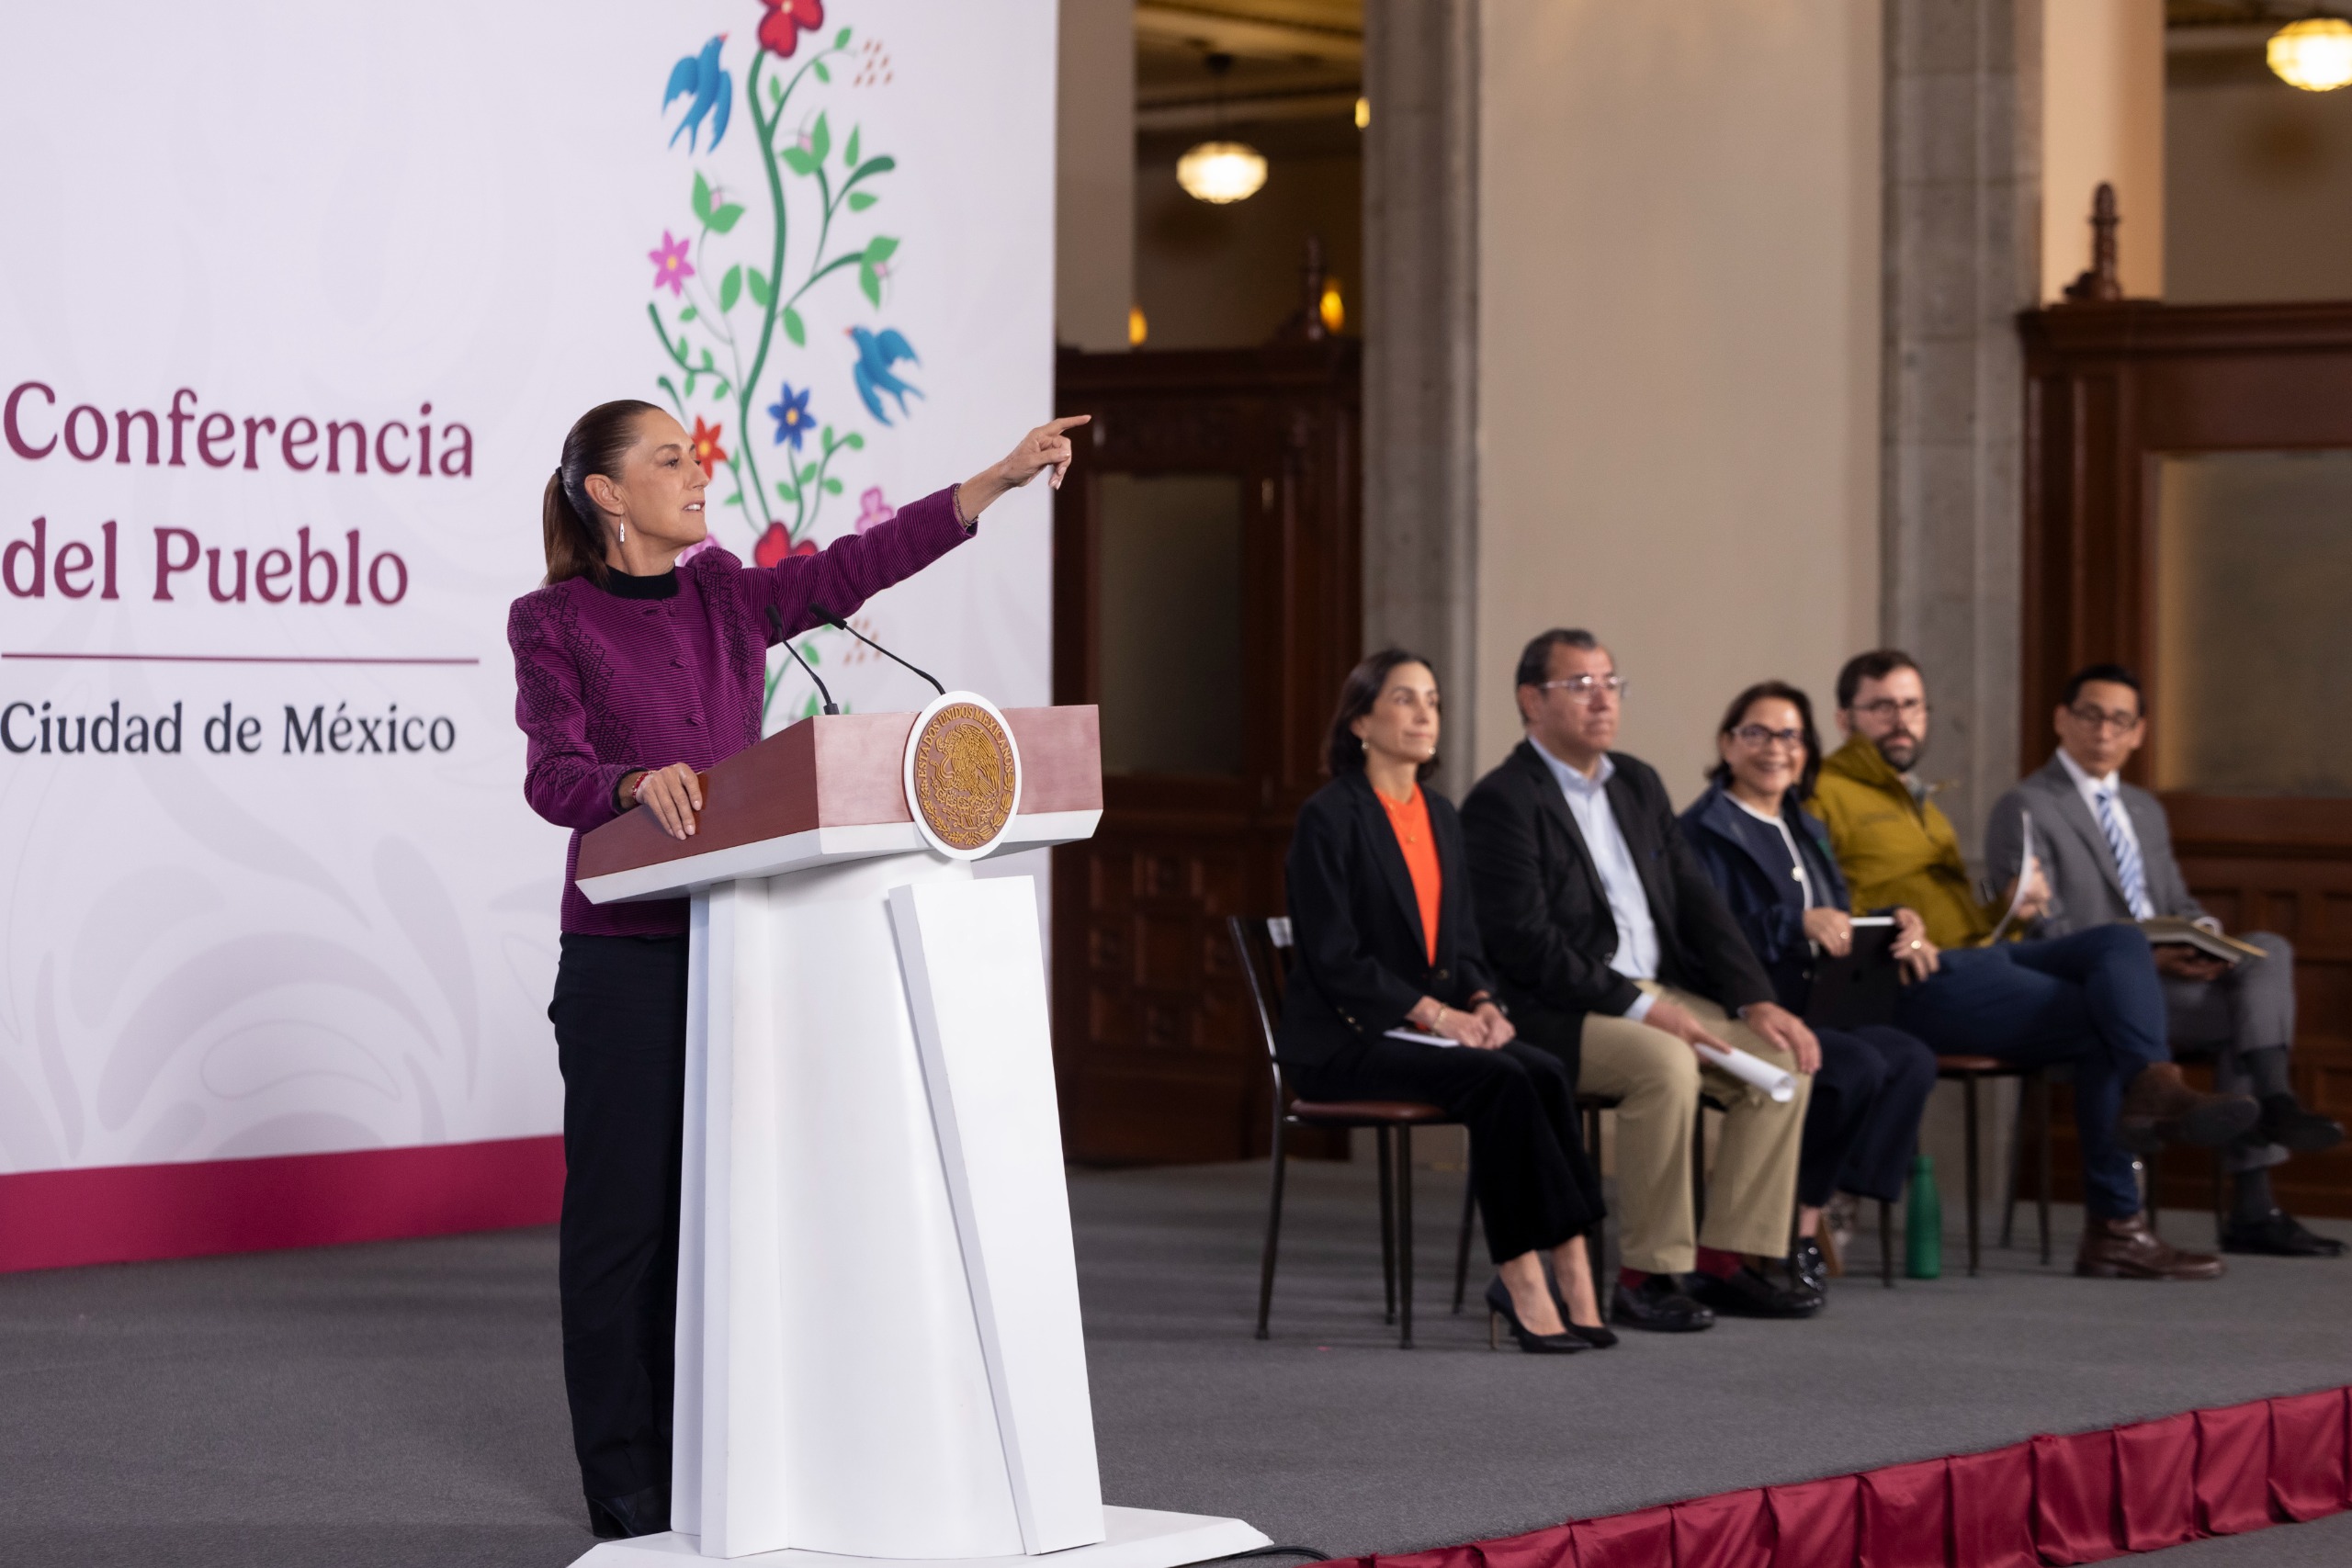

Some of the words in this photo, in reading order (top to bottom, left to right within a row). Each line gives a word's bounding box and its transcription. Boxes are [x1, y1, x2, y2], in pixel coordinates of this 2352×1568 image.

[3, 380, 473, 478] Conferencia
[2, 515, 120, 601] del
[152, 525, 409, 606] Pueblo
[0, 699, 184, 755] Ciudad
[203, 701, 262, 755] de
[282, 701, 457, 755] México
[917, 720, 941, 778] ESTADOS
[936, 705, 973, 727] UNIDOS
[974, 706, 1014, 773] MEXICANOS
